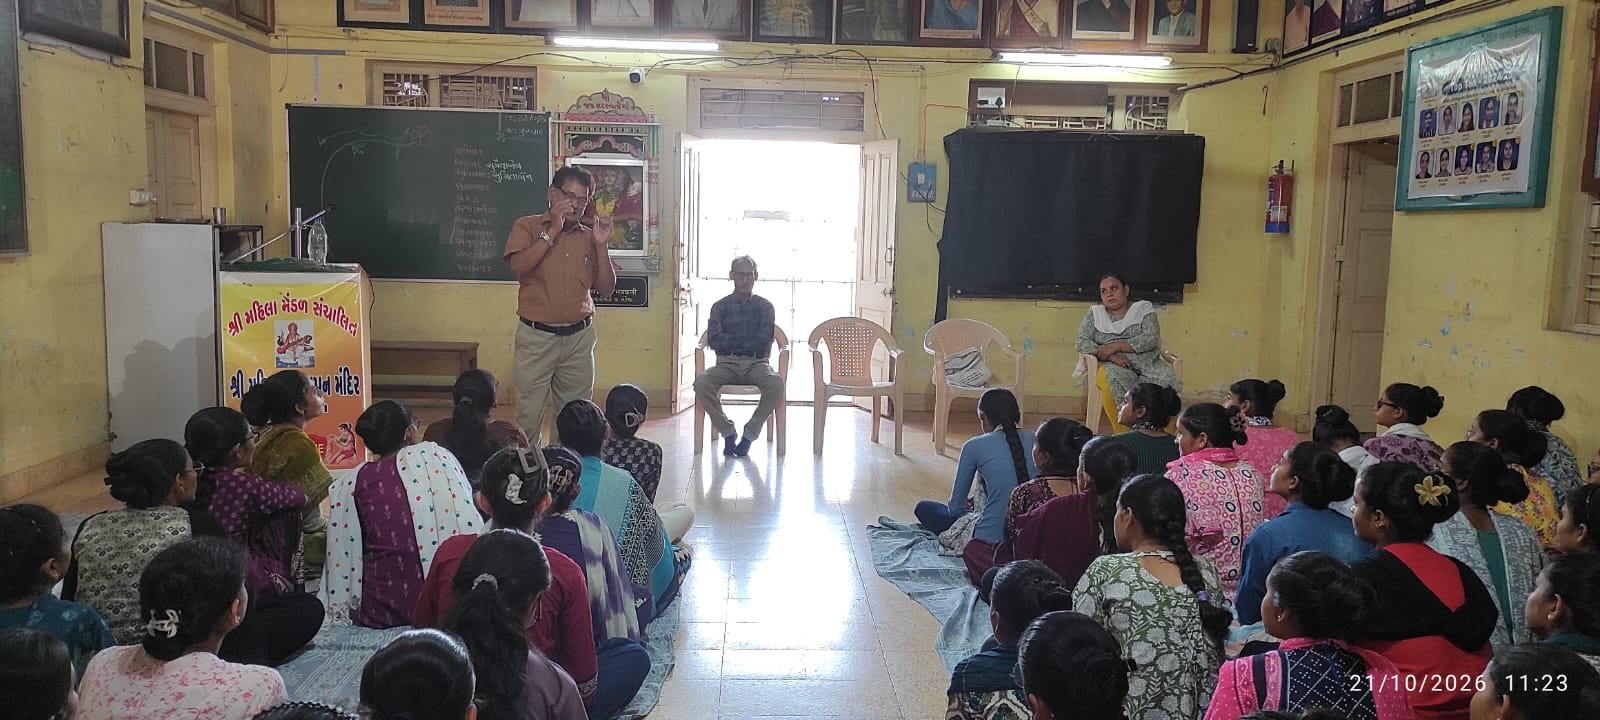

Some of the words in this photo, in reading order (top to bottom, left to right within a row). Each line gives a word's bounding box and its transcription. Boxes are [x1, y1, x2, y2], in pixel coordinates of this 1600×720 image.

[228, 312, 243, 336] શ્રી
[244, 300, 278, 324] મહિલા
[312, 297, 358, 337] સંચાલિત
[230, 369, 243, 398] શ્રી
[335, 366, 360, 396] મંદિર
